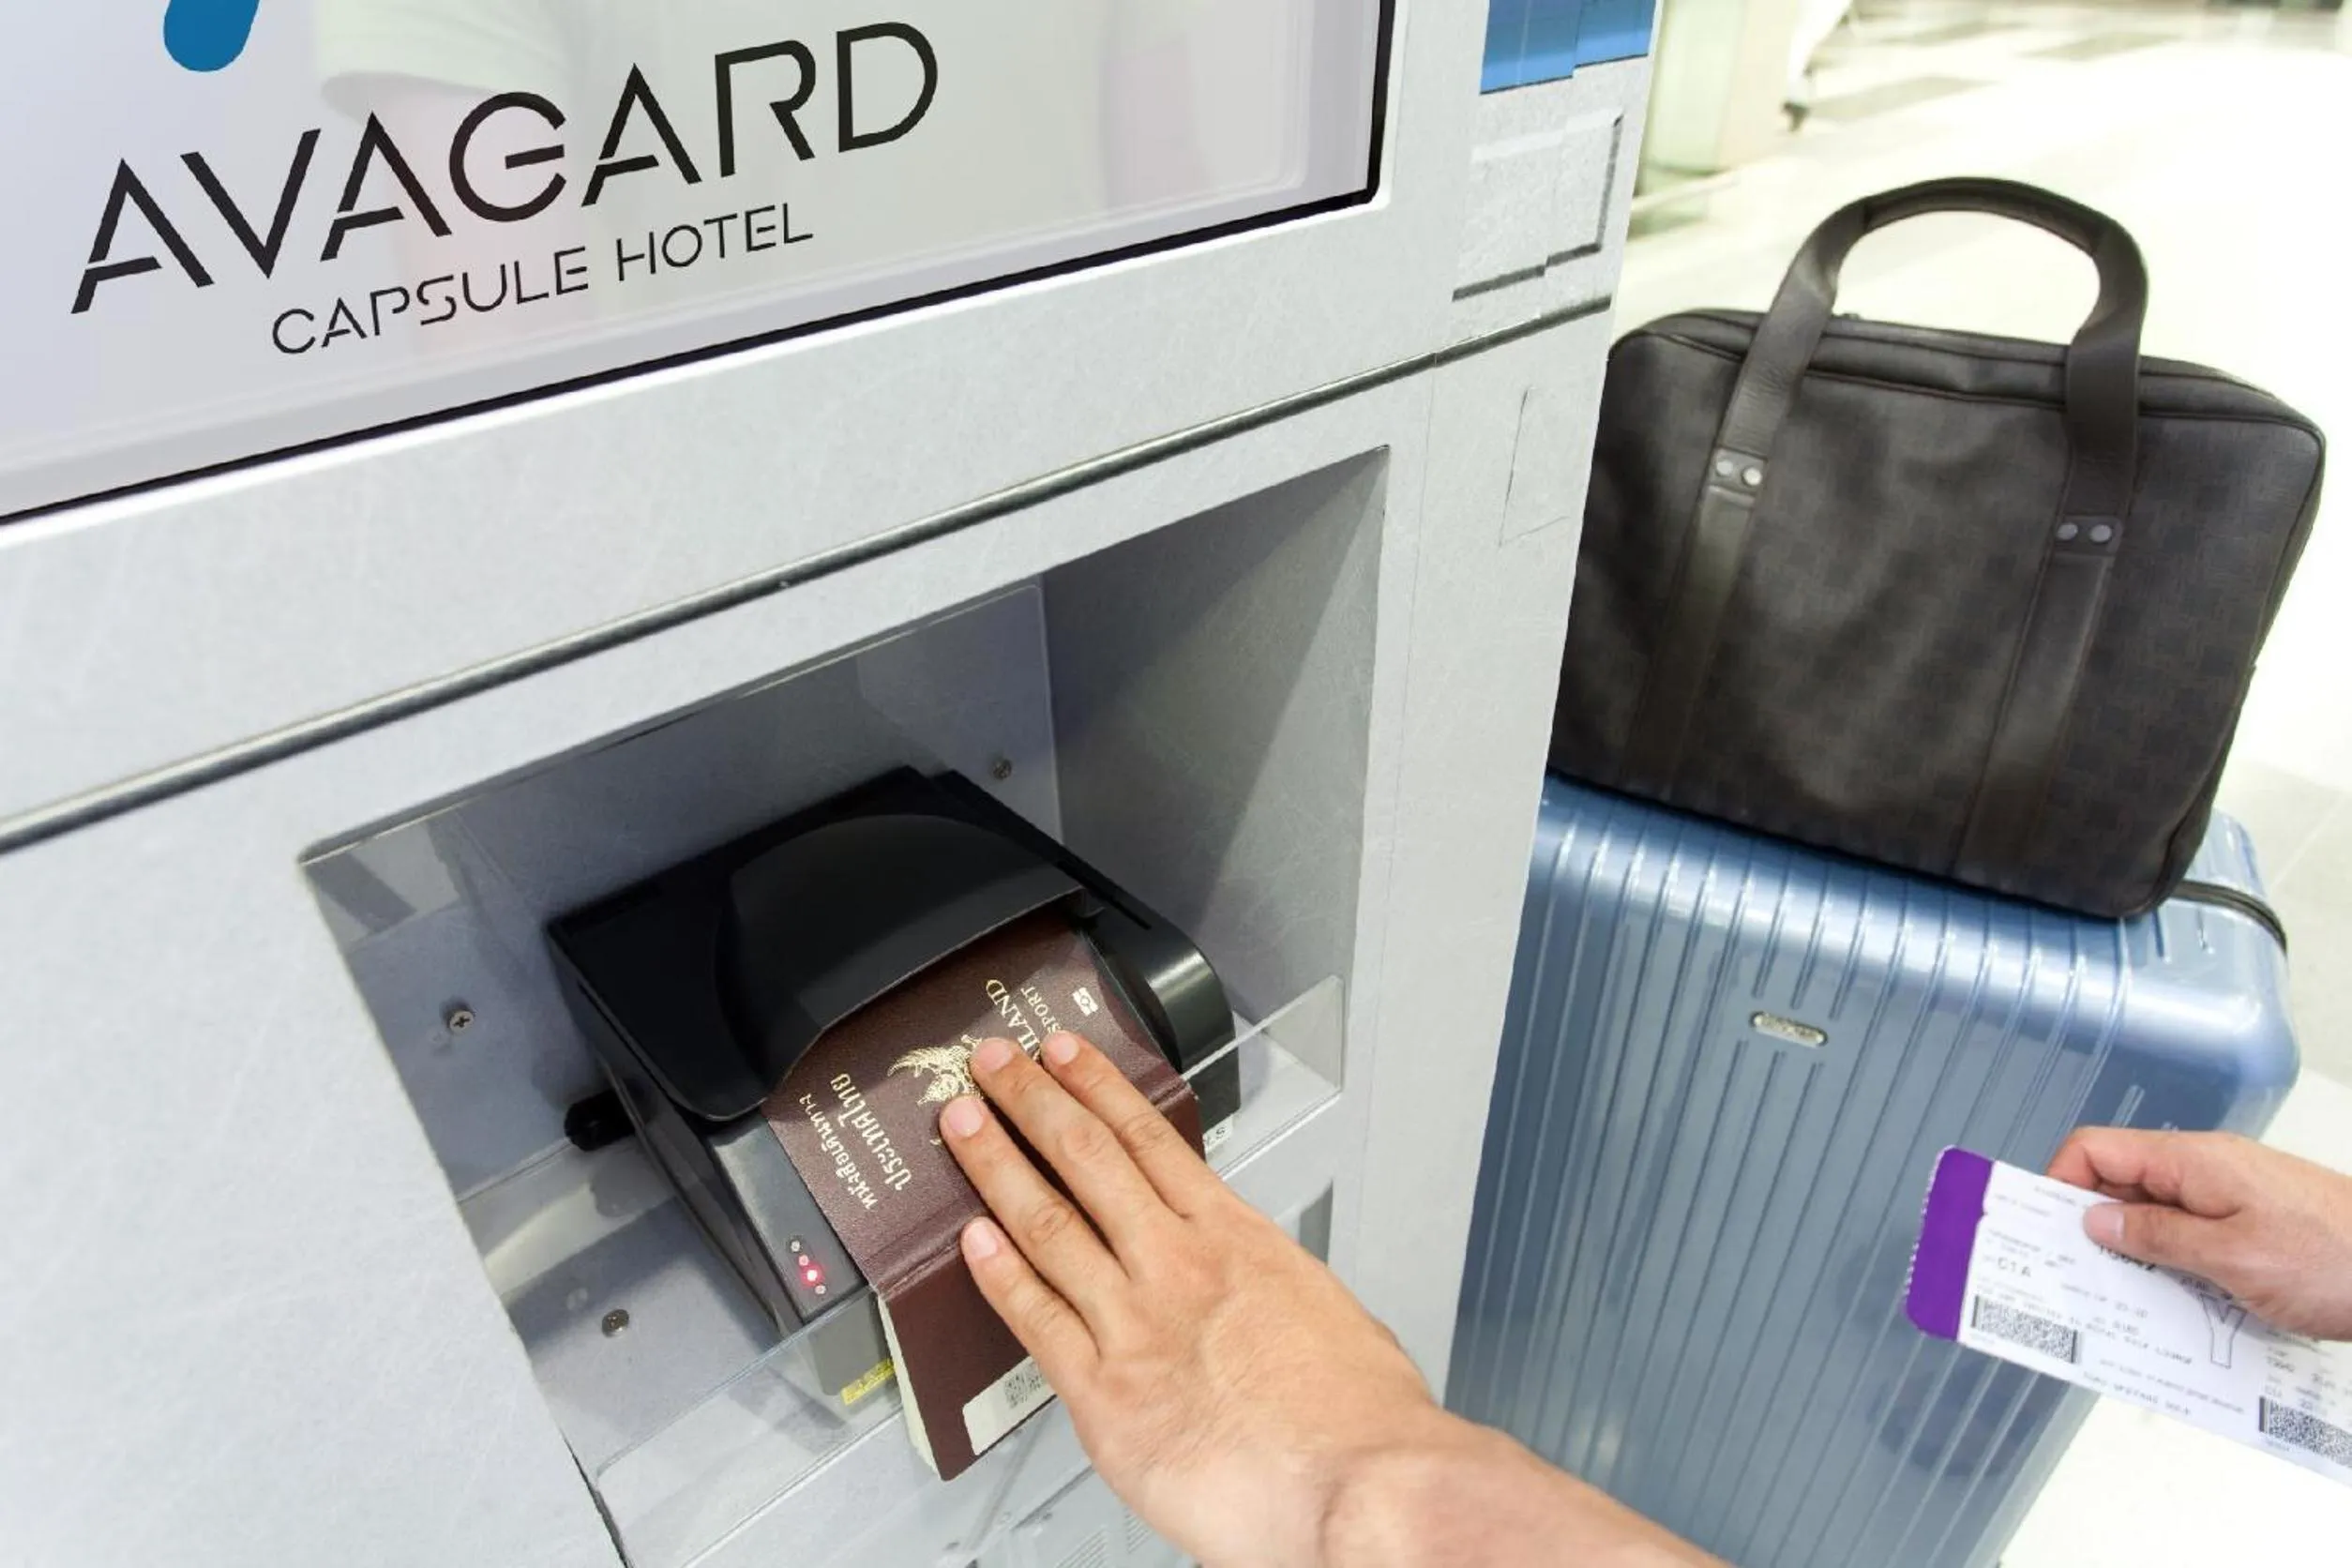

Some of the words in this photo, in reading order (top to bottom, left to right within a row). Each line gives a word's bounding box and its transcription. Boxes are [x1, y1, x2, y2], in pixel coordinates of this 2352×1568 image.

[71, 22, 938, 314] AVAGARD
[272, 247, 588, 355] CAPSULE
[616, 202, 814, 283] HOTEL
[986, 979, 1041, 1061] ILAND
[1020, 987, 1062, 1034] SPORT
[799, 1093, 879, 1210] หนังสือเดินทาง
[830, 1073, 912, 1191] ประเทศไทย
